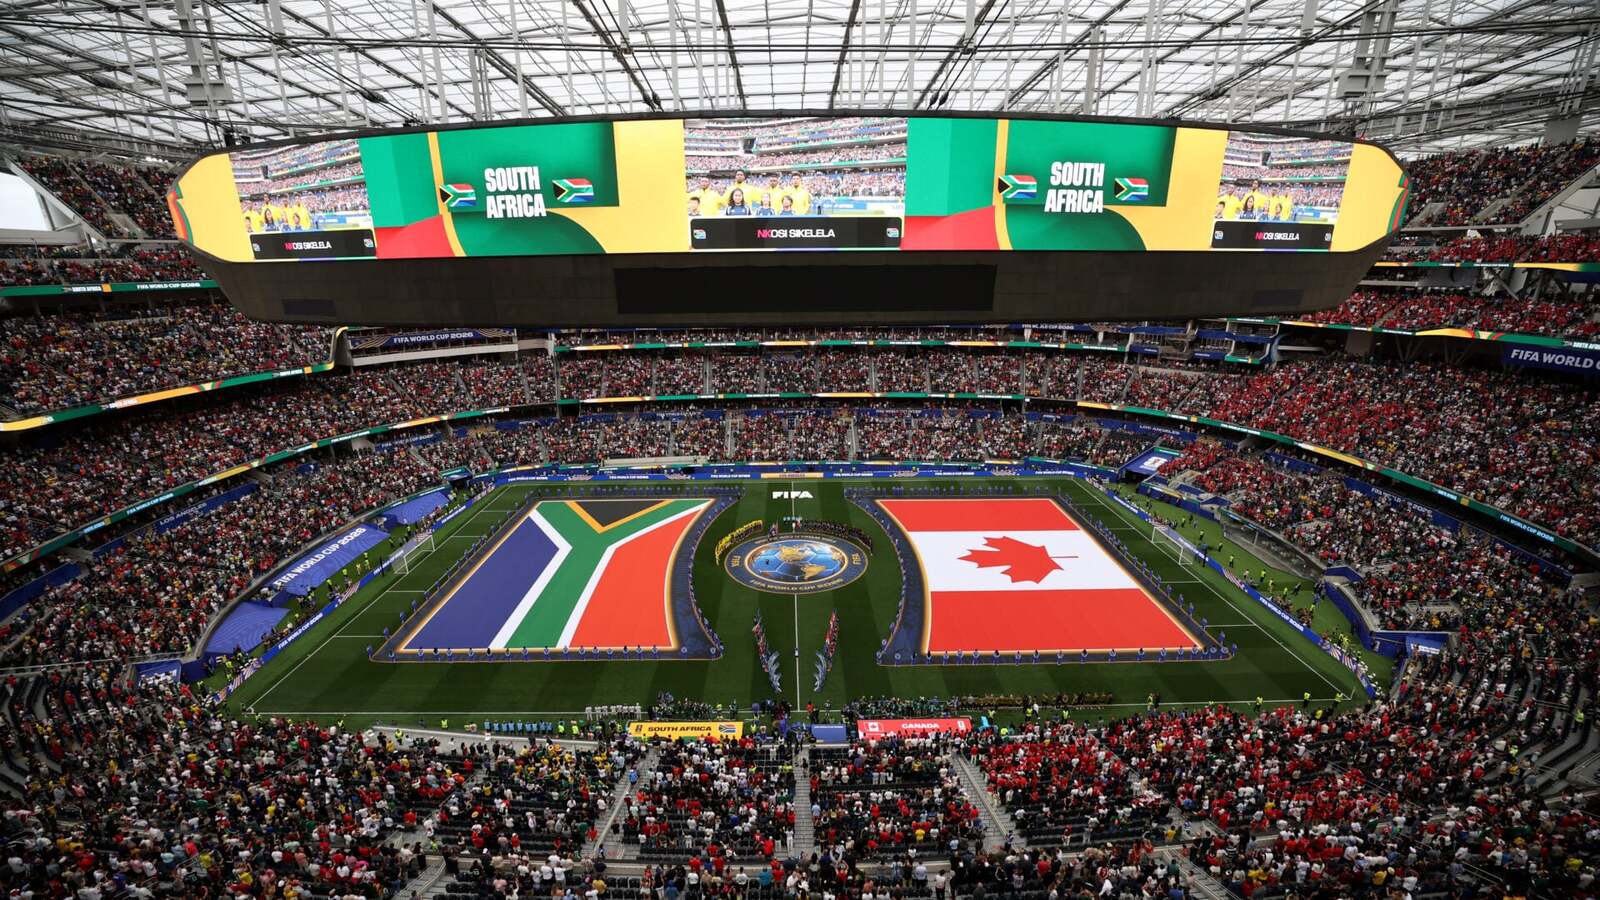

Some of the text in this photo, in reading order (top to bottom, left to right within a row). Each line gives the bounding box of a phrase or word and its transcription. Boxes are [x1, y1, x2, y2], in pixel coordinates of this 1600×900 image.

[484, 166, 541, 192] SOUTH
[1050, 161, 1105, 186] SOUTH
[486, 193, 548, 219] AFRICA
[1044, 189, 1104, 213] AFRICA
[757, 229, 836, 238] NKOSI SIKELELA
[394, 335, 409, 344] FIFA
[411, 334, 435, 343] WORLD
[450, 331, 474, 339] 2026
[1511, 349, 1539, 362] FIFA
[1541, 353, 1594, 369] WORLD
[772, 491, 814, 499] FIFA
[272, 527, 366, 586] FIFA WORLD CUP 2026
